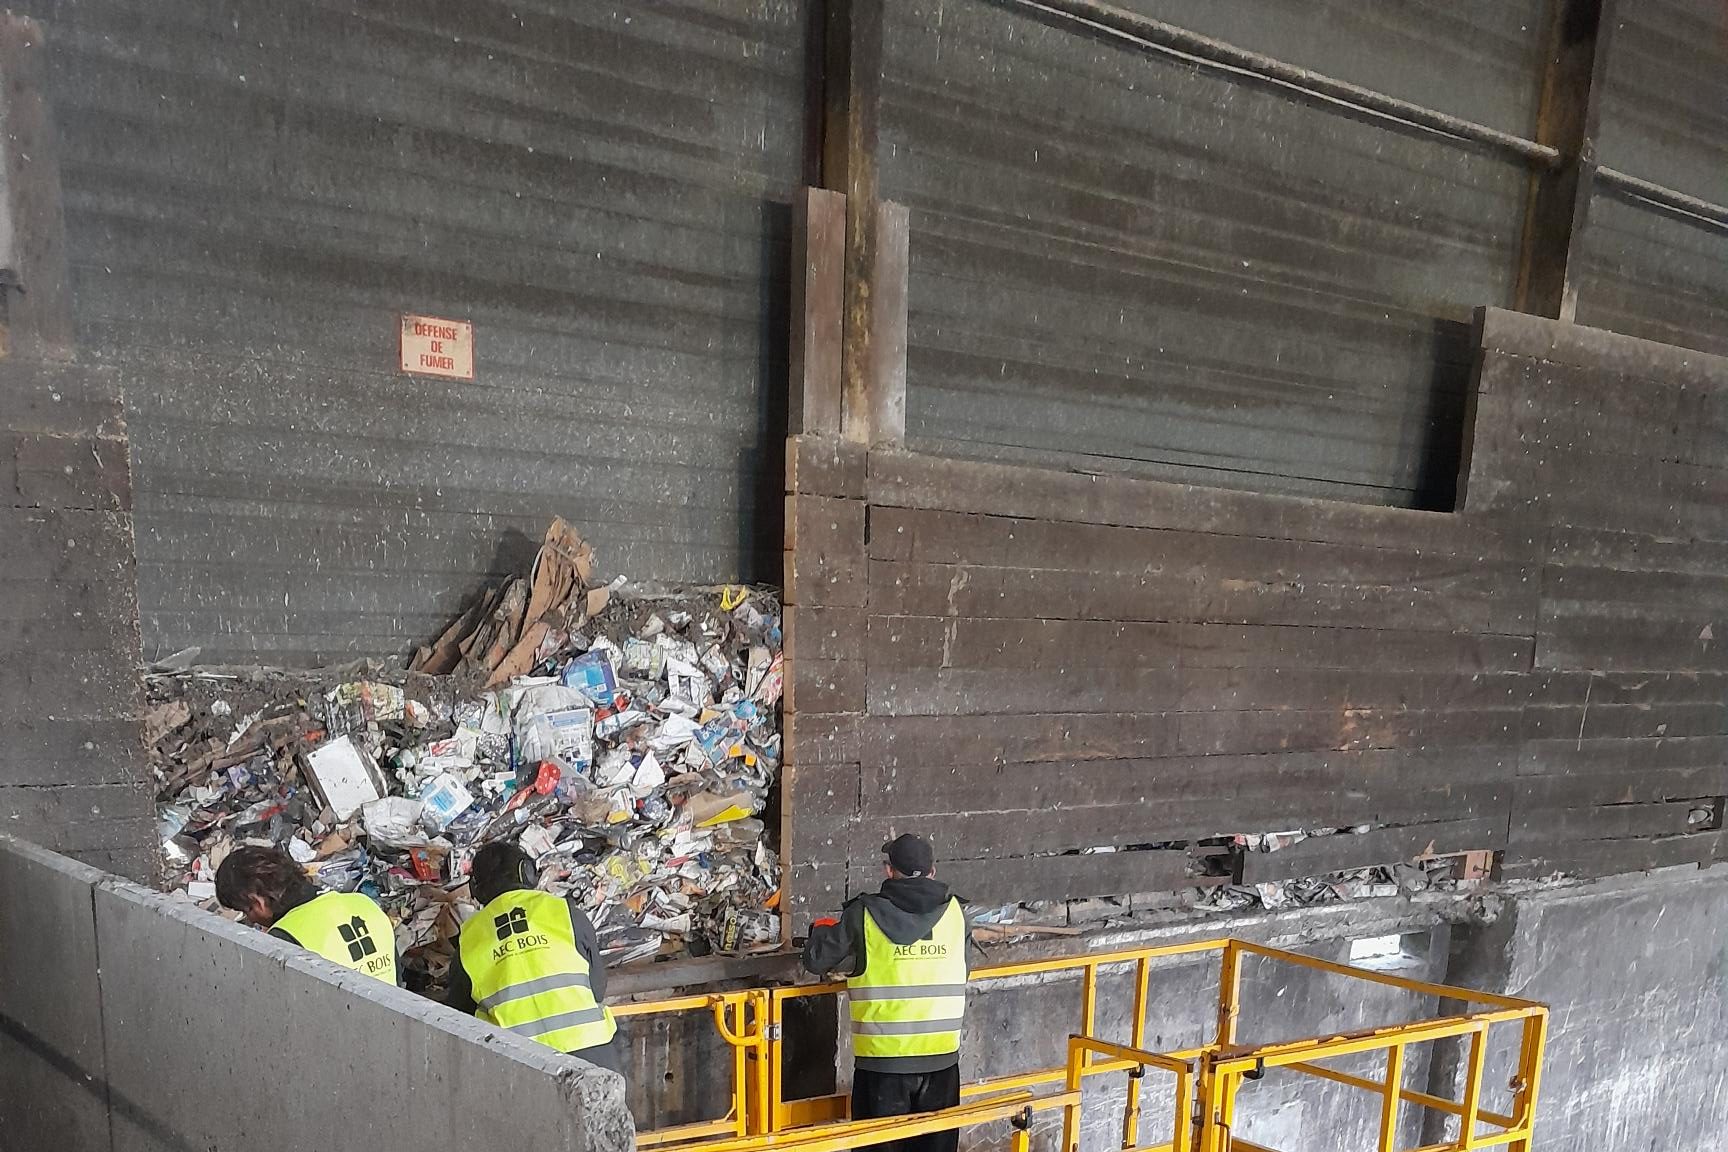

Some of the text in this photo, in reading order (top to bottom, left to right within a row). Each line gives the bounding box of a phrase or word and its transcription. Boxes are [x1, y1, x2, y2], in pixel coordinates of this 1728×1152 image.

[414, 322, 458, 340] DEFENSE
[430, 340, 443, 354] DE
[419, 354, 454, 370] FUMER
[492, 941, 514, 961] AEC
[516, 934, 549, 950] BOIS
[893, 944, 947, 956] AEC BOIS
[366, 953, 391, 973] BOIS
